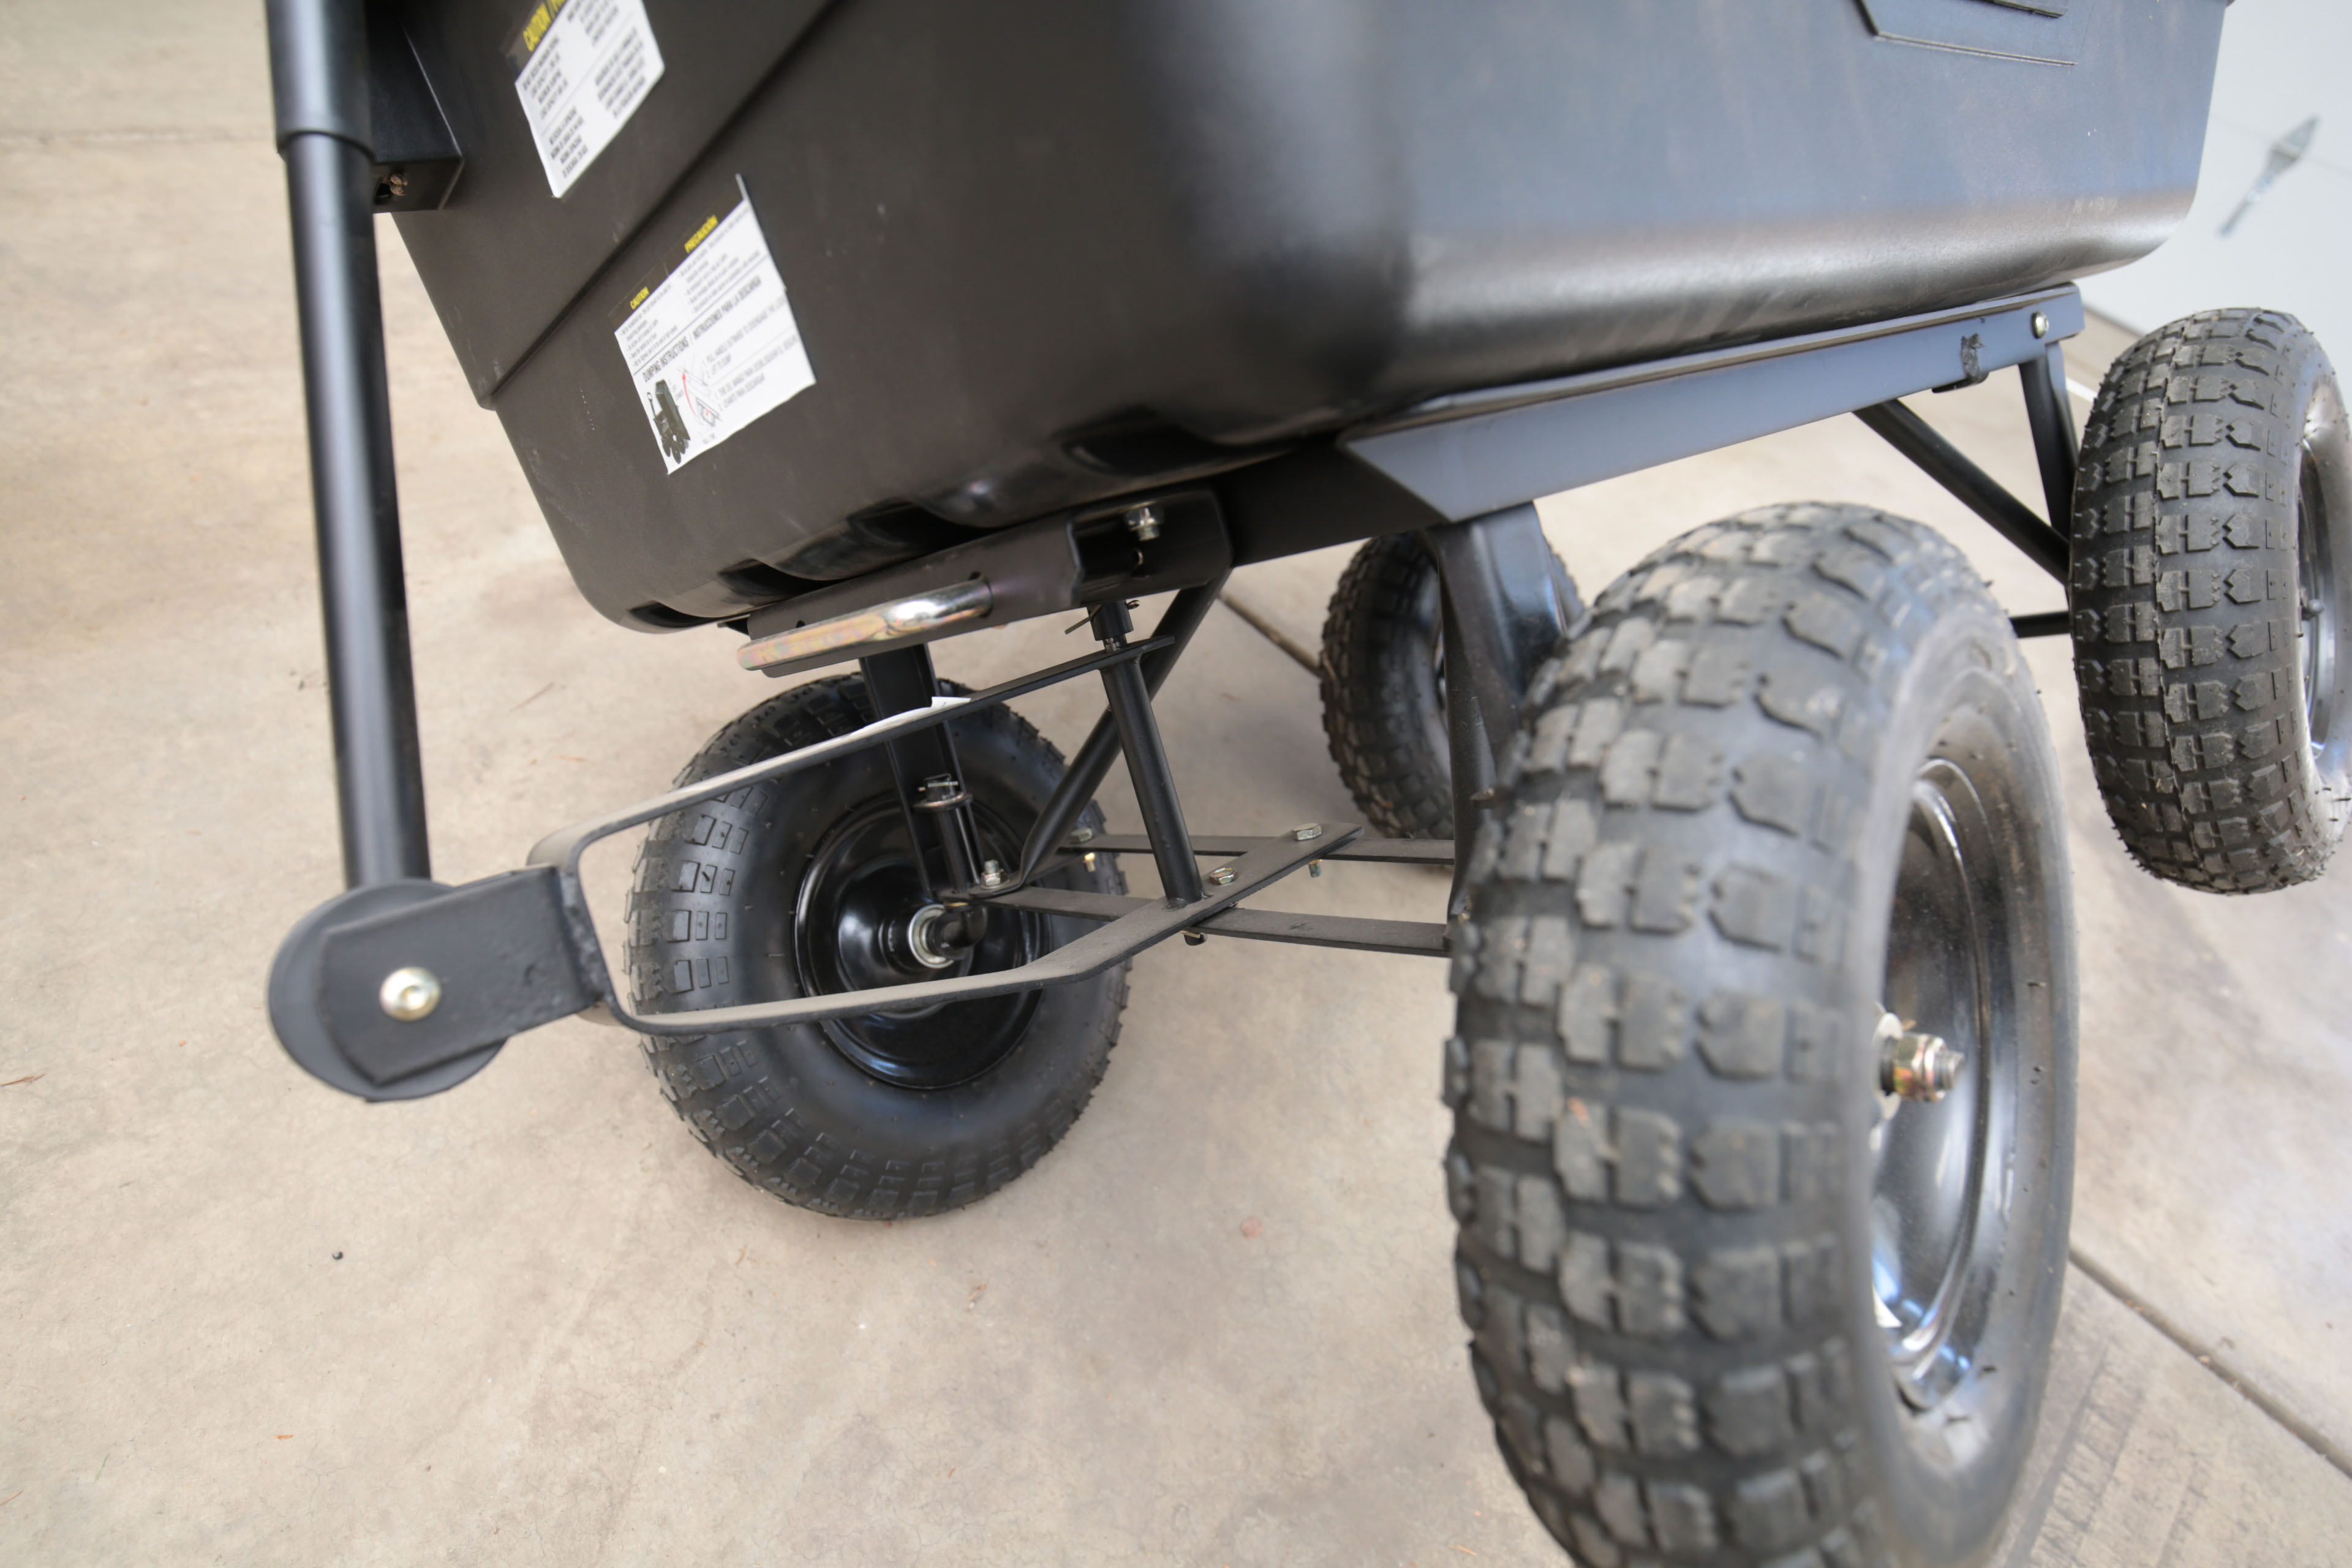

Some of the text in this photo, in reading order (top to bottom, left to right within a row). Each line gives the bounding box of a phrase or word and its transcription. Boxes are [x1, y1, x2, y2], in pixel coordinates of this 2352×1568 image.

[523, 2, 551, 51] CAUTION
[630, 286, 650, 310] CAUTION
[643, 360, 662, 382] DUMPING
[659, 336, 689, 368] INSTRUCTIONS
[693, 308, 723, 340] INSTRUCCIONES
